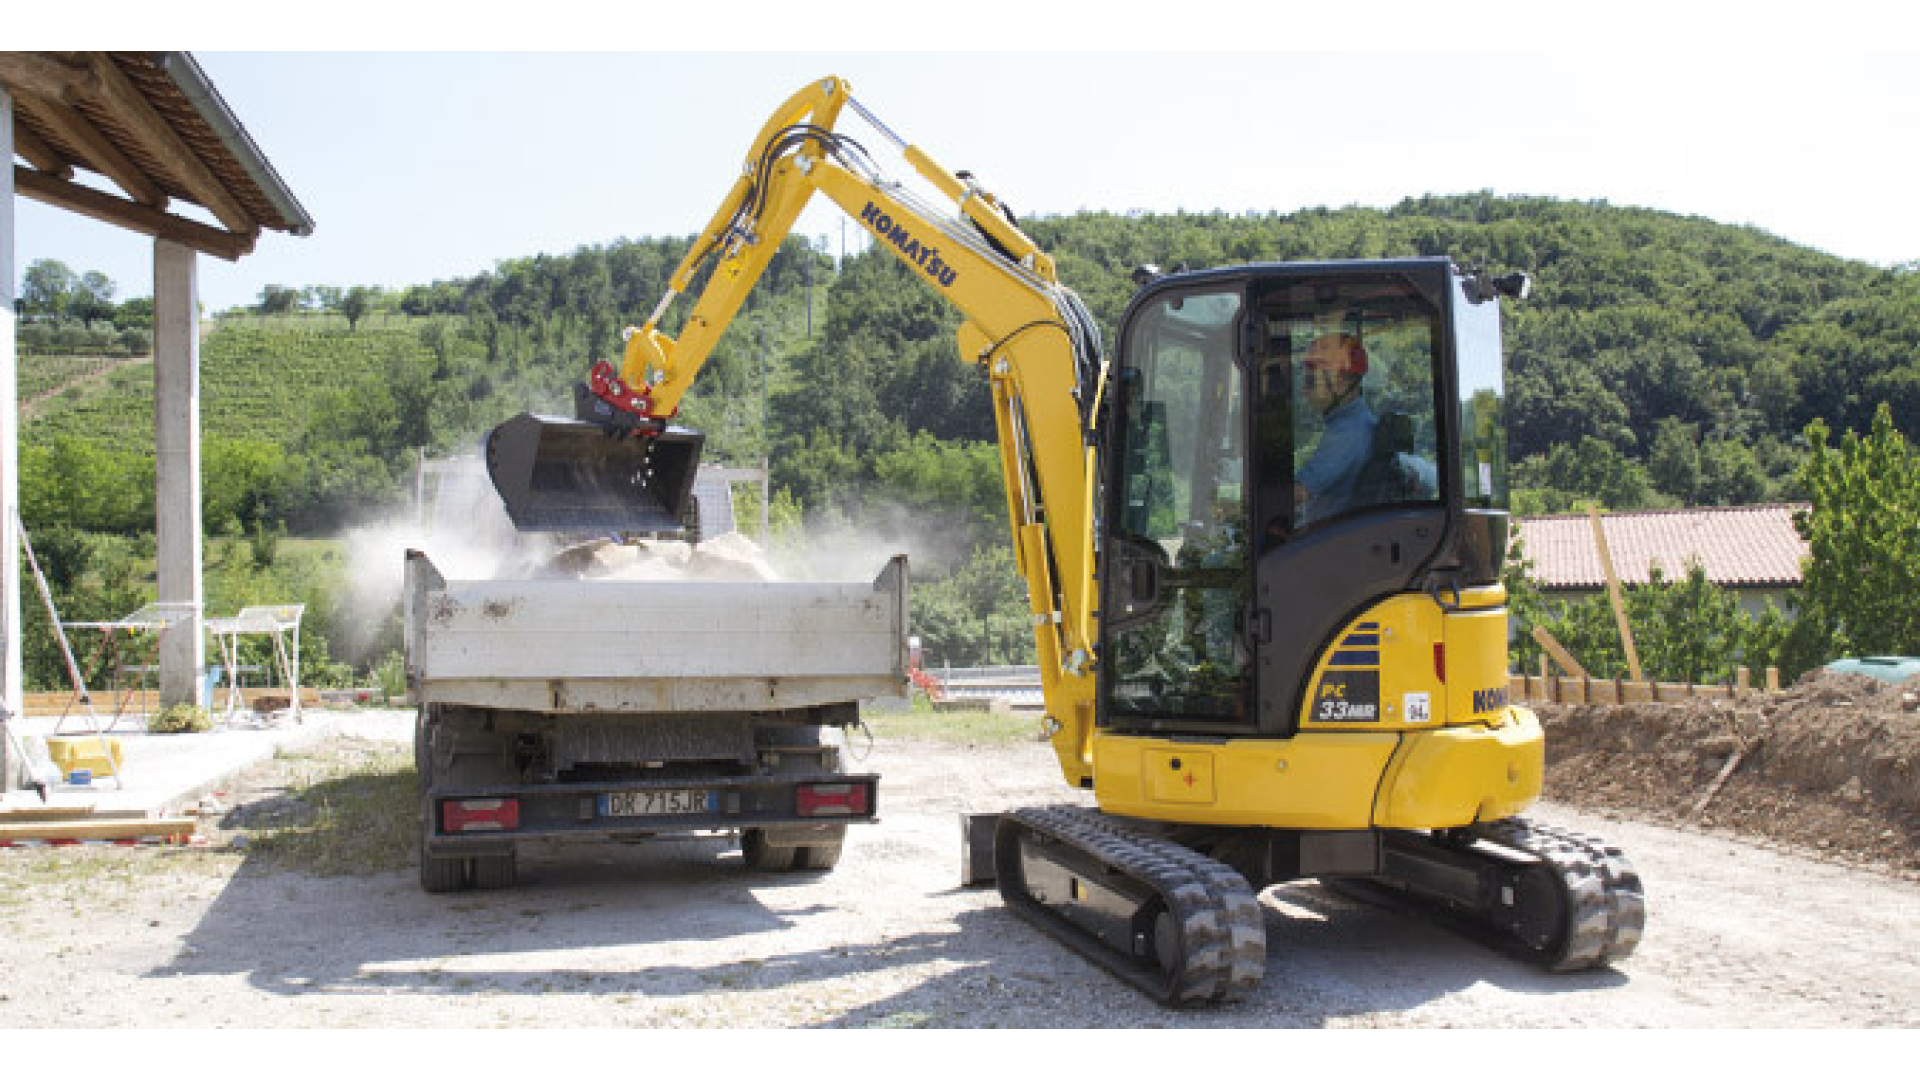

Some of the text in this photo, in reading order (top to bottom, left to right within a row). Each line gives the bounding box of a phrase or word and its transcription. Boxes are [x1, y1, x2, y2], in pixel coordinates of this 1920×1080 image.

[861, 201, 957, 287] KOMATSU
[1321, 683, 1346, 697] PC
[1320, 700, 1377, 719] 33MR
